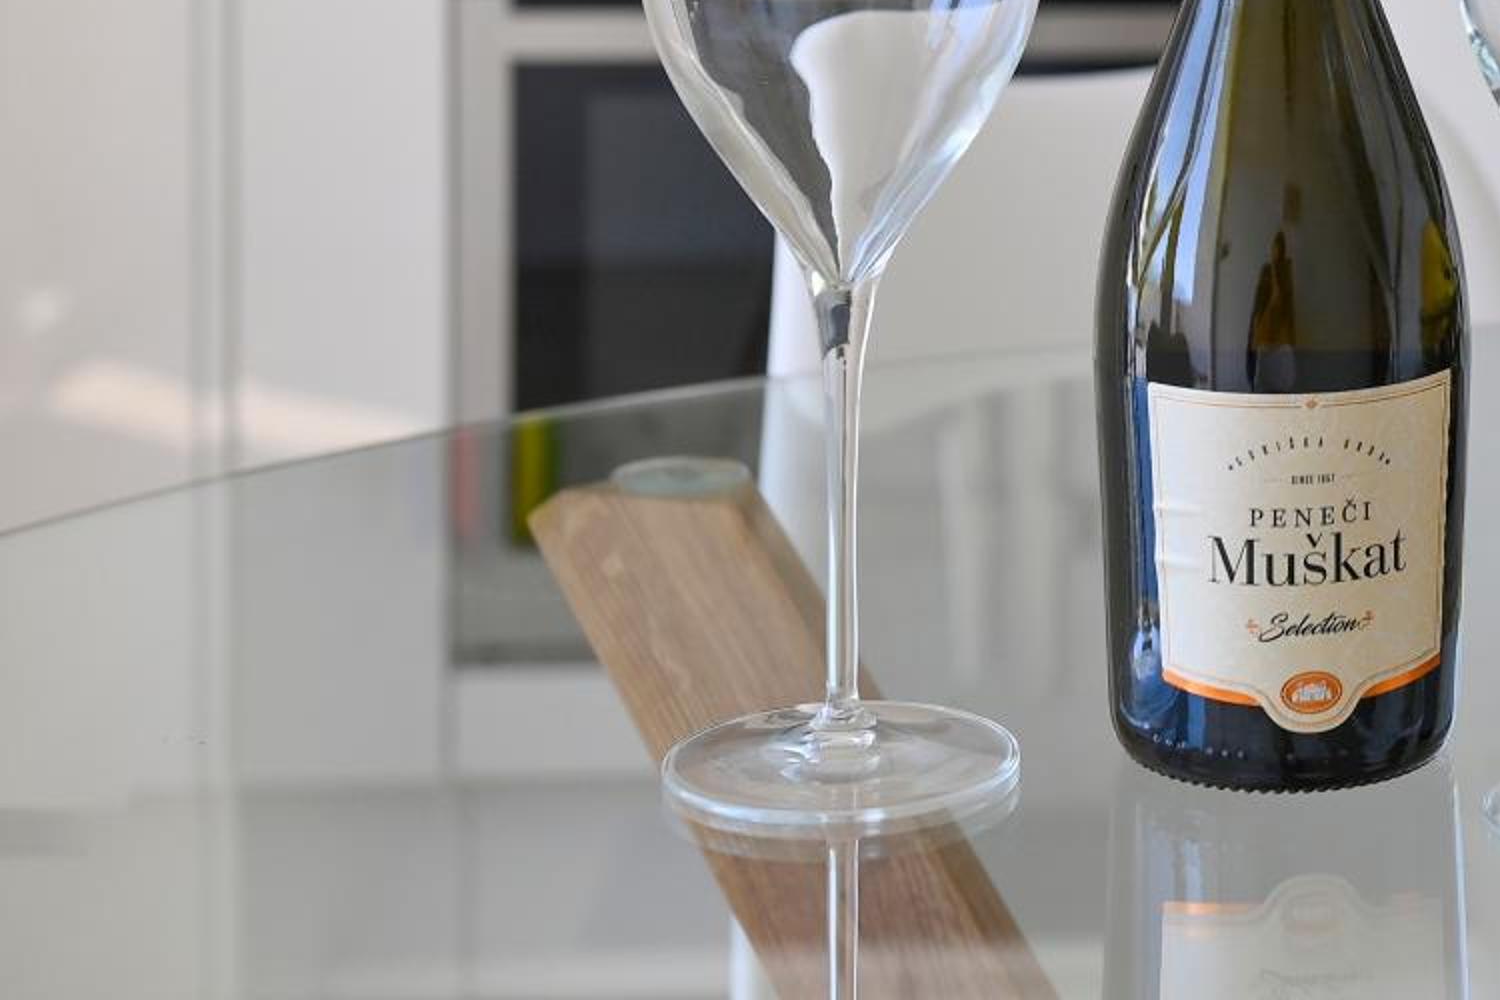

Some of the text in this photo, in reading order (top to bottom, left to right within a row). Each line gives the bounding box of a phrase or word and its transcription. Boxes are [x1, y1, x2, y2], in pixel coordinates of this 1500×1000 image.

[1249, 497, 1371, 529] PENEČI
[1207, 528, 1407, 587] Muškat
[1258, 612, 1361, 643] Selection
